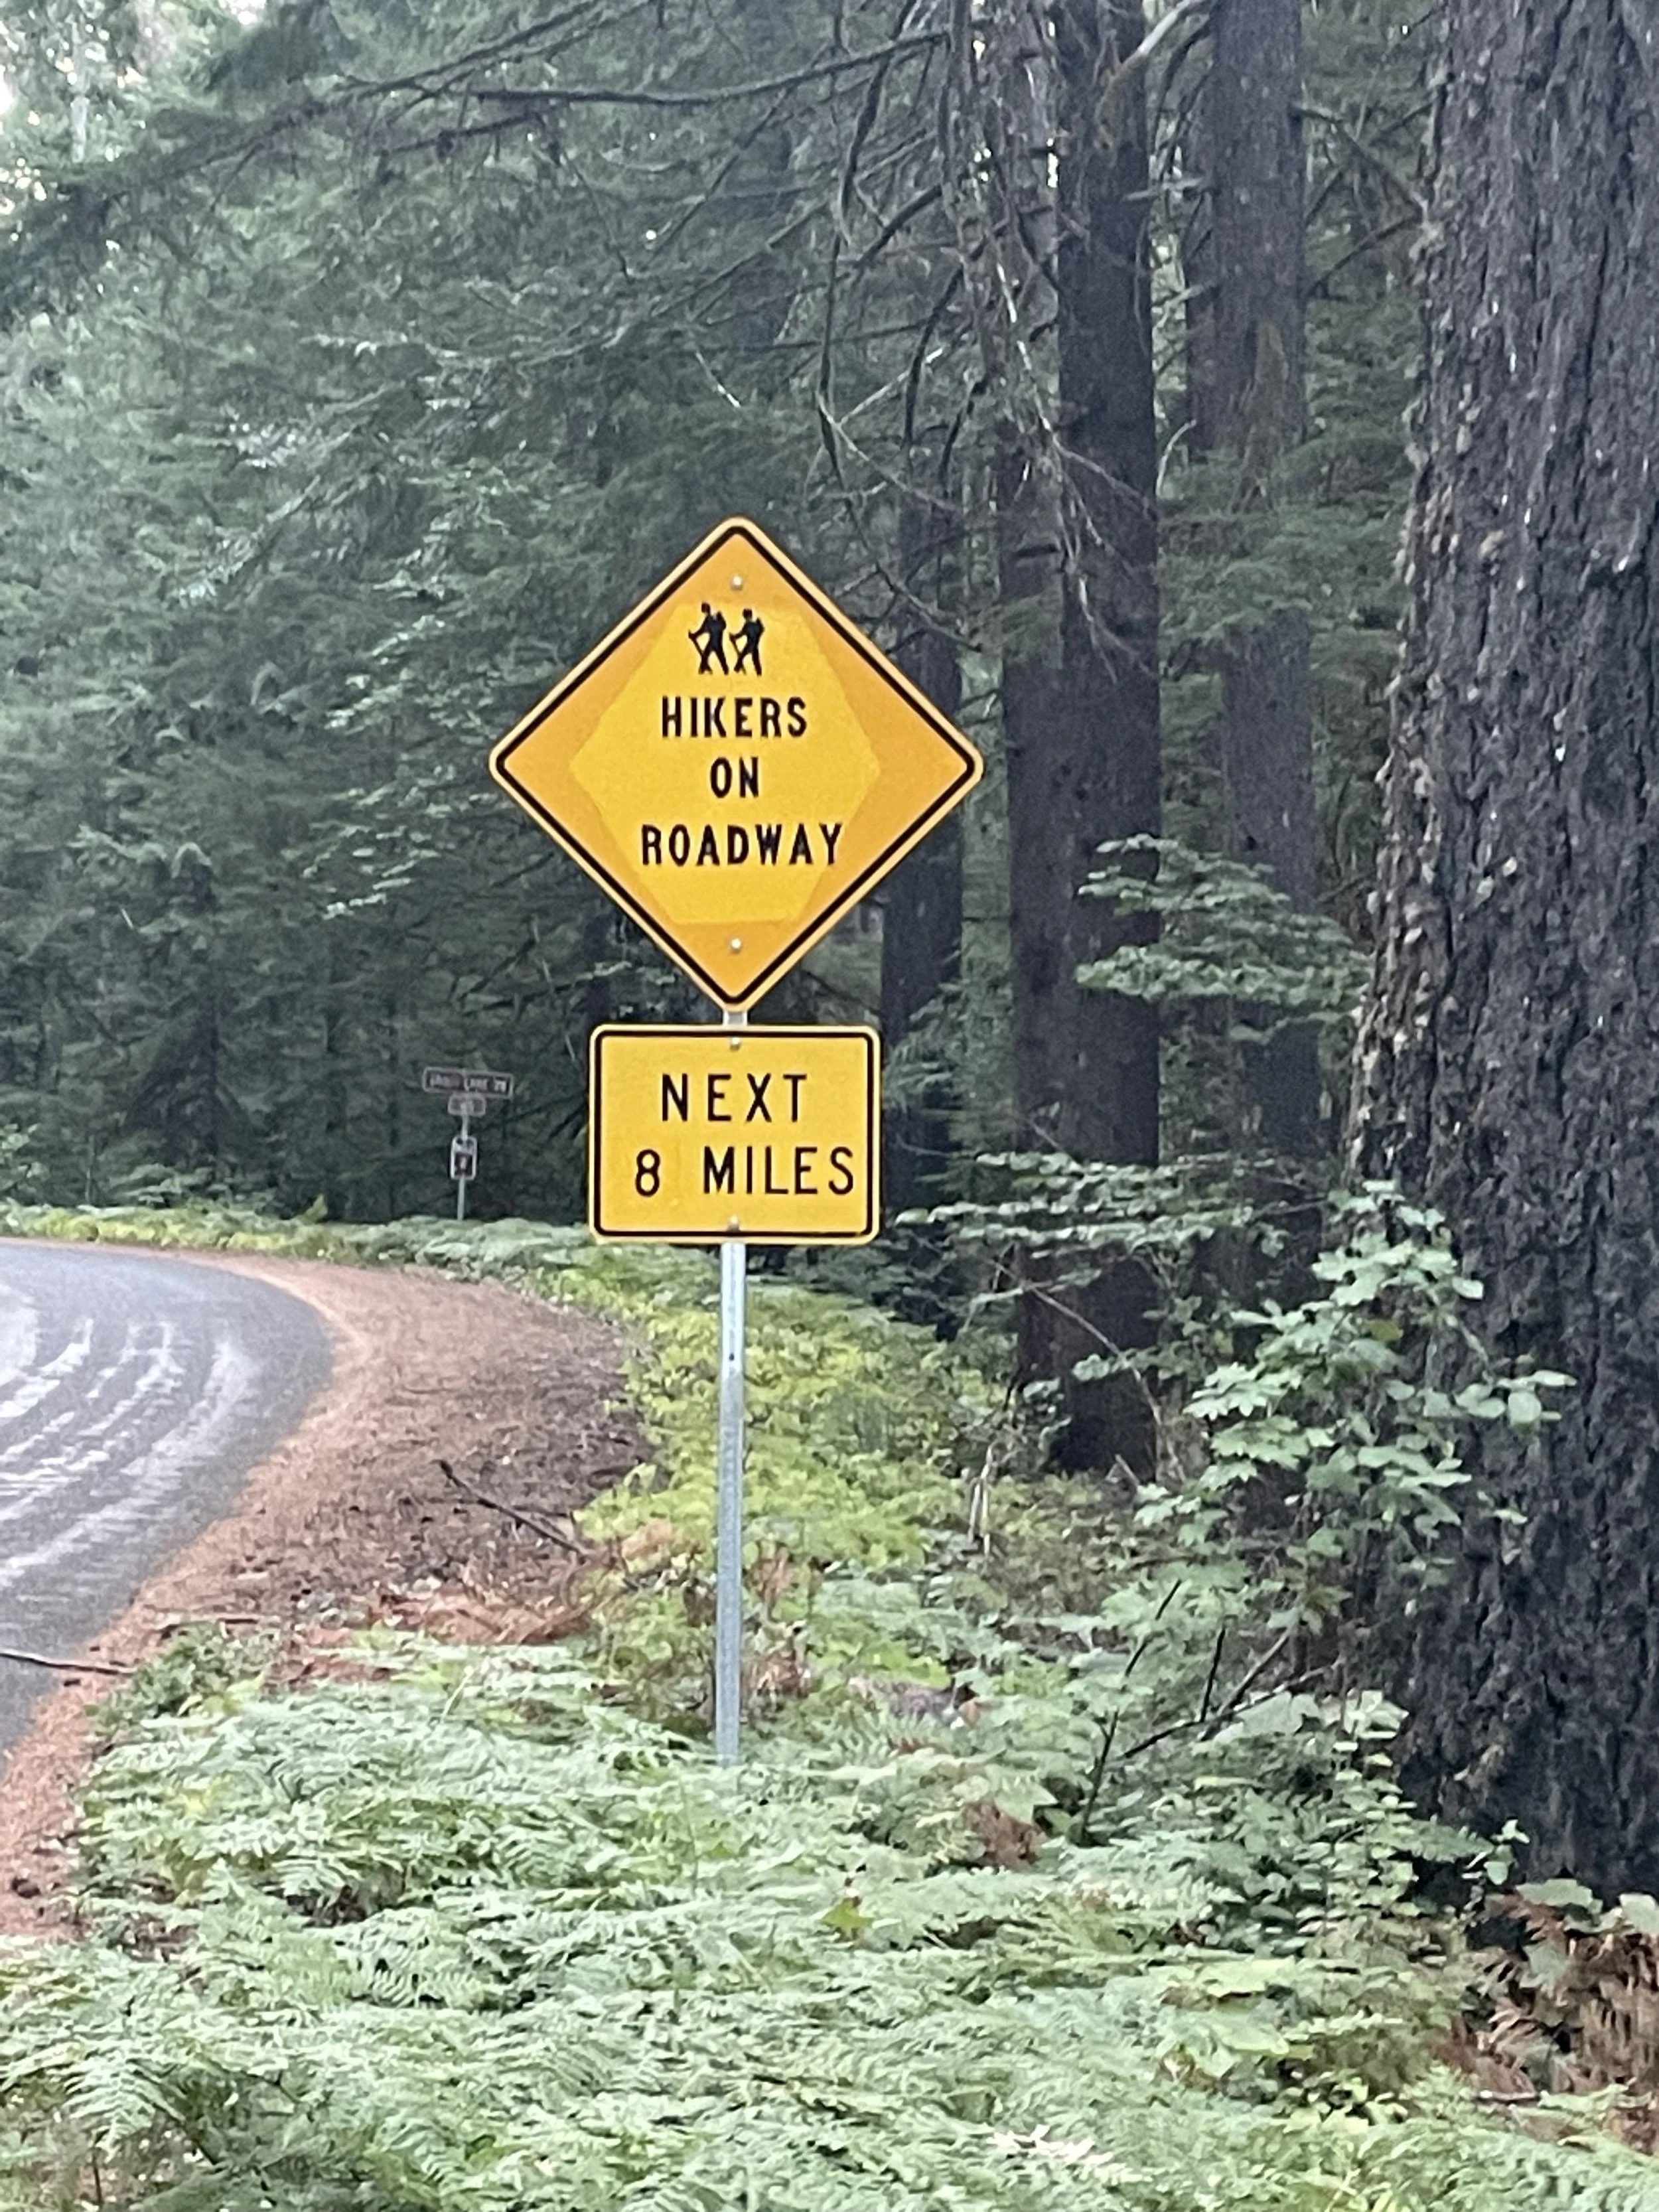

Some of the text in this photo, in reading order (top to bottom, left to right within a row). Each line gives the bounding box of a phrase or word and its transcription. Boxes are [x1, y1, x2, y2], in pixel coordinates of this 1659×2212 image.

[662, 696, 808, 738] HIKERS
[710, 757, 759, 798] ON
[641, 823, 843, 867] ROADWAY
[662, 1072, 808, 1123] NEXT
[634, 1145, 854, 1197] 8 MILES
